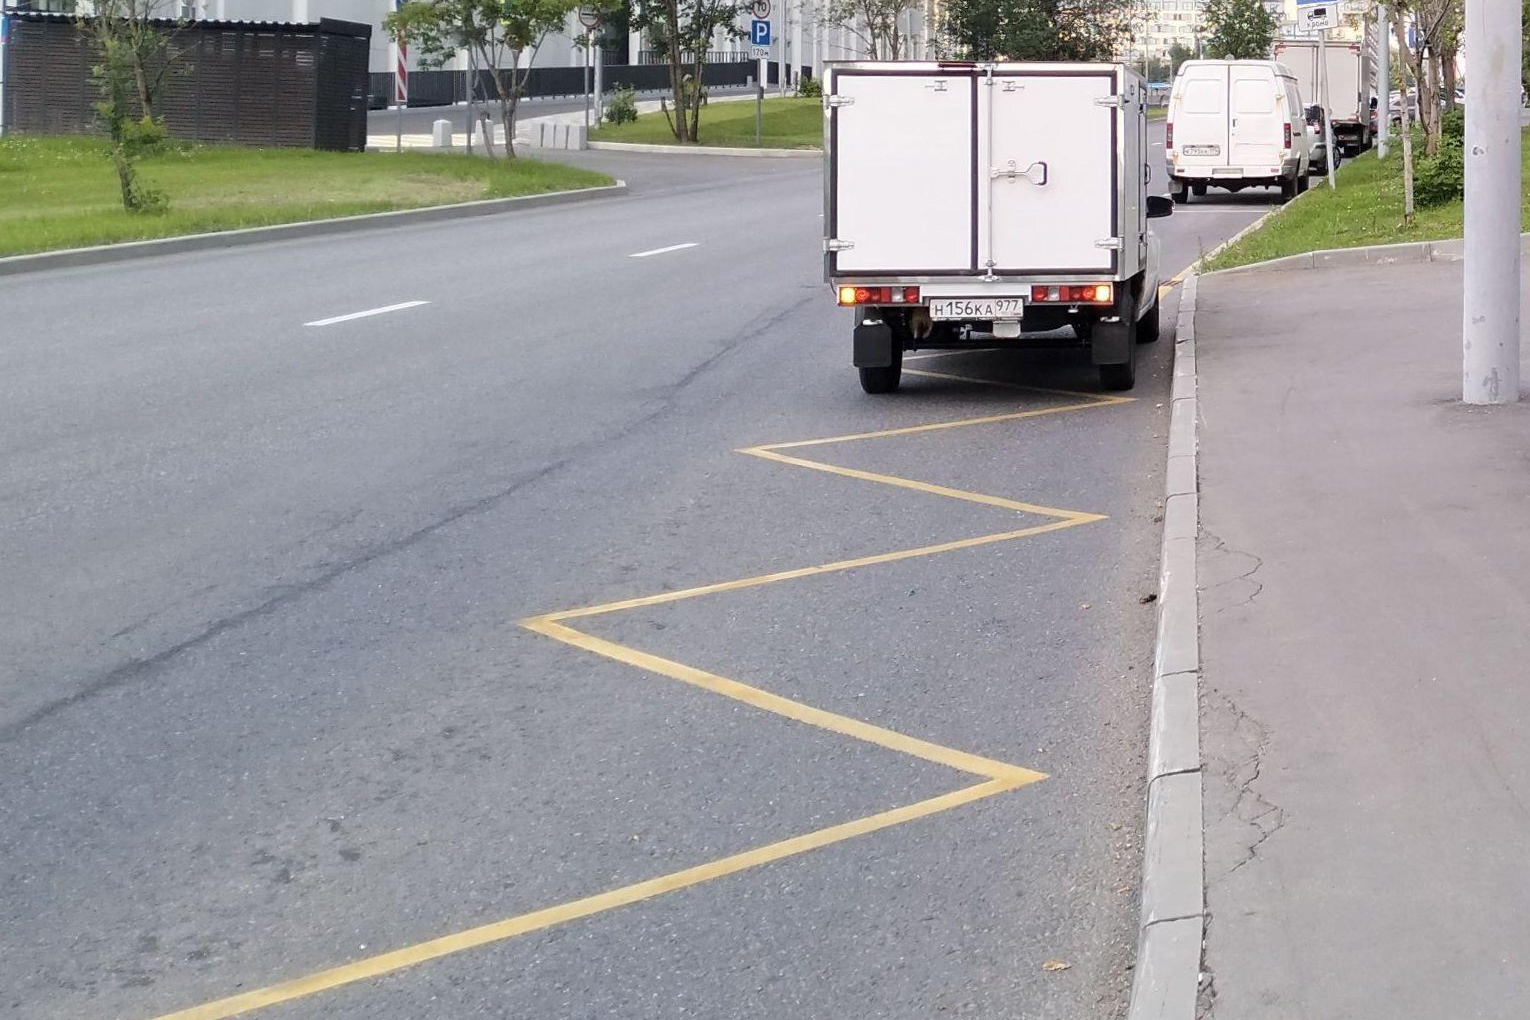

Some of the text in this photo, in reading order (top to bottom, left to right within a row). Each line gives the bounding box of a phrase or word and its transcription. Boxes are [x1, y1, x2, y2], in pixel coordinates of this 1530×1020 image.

[756, 22, 768, 43] P
[934, 299, 1019, 316] Н156КА 977
